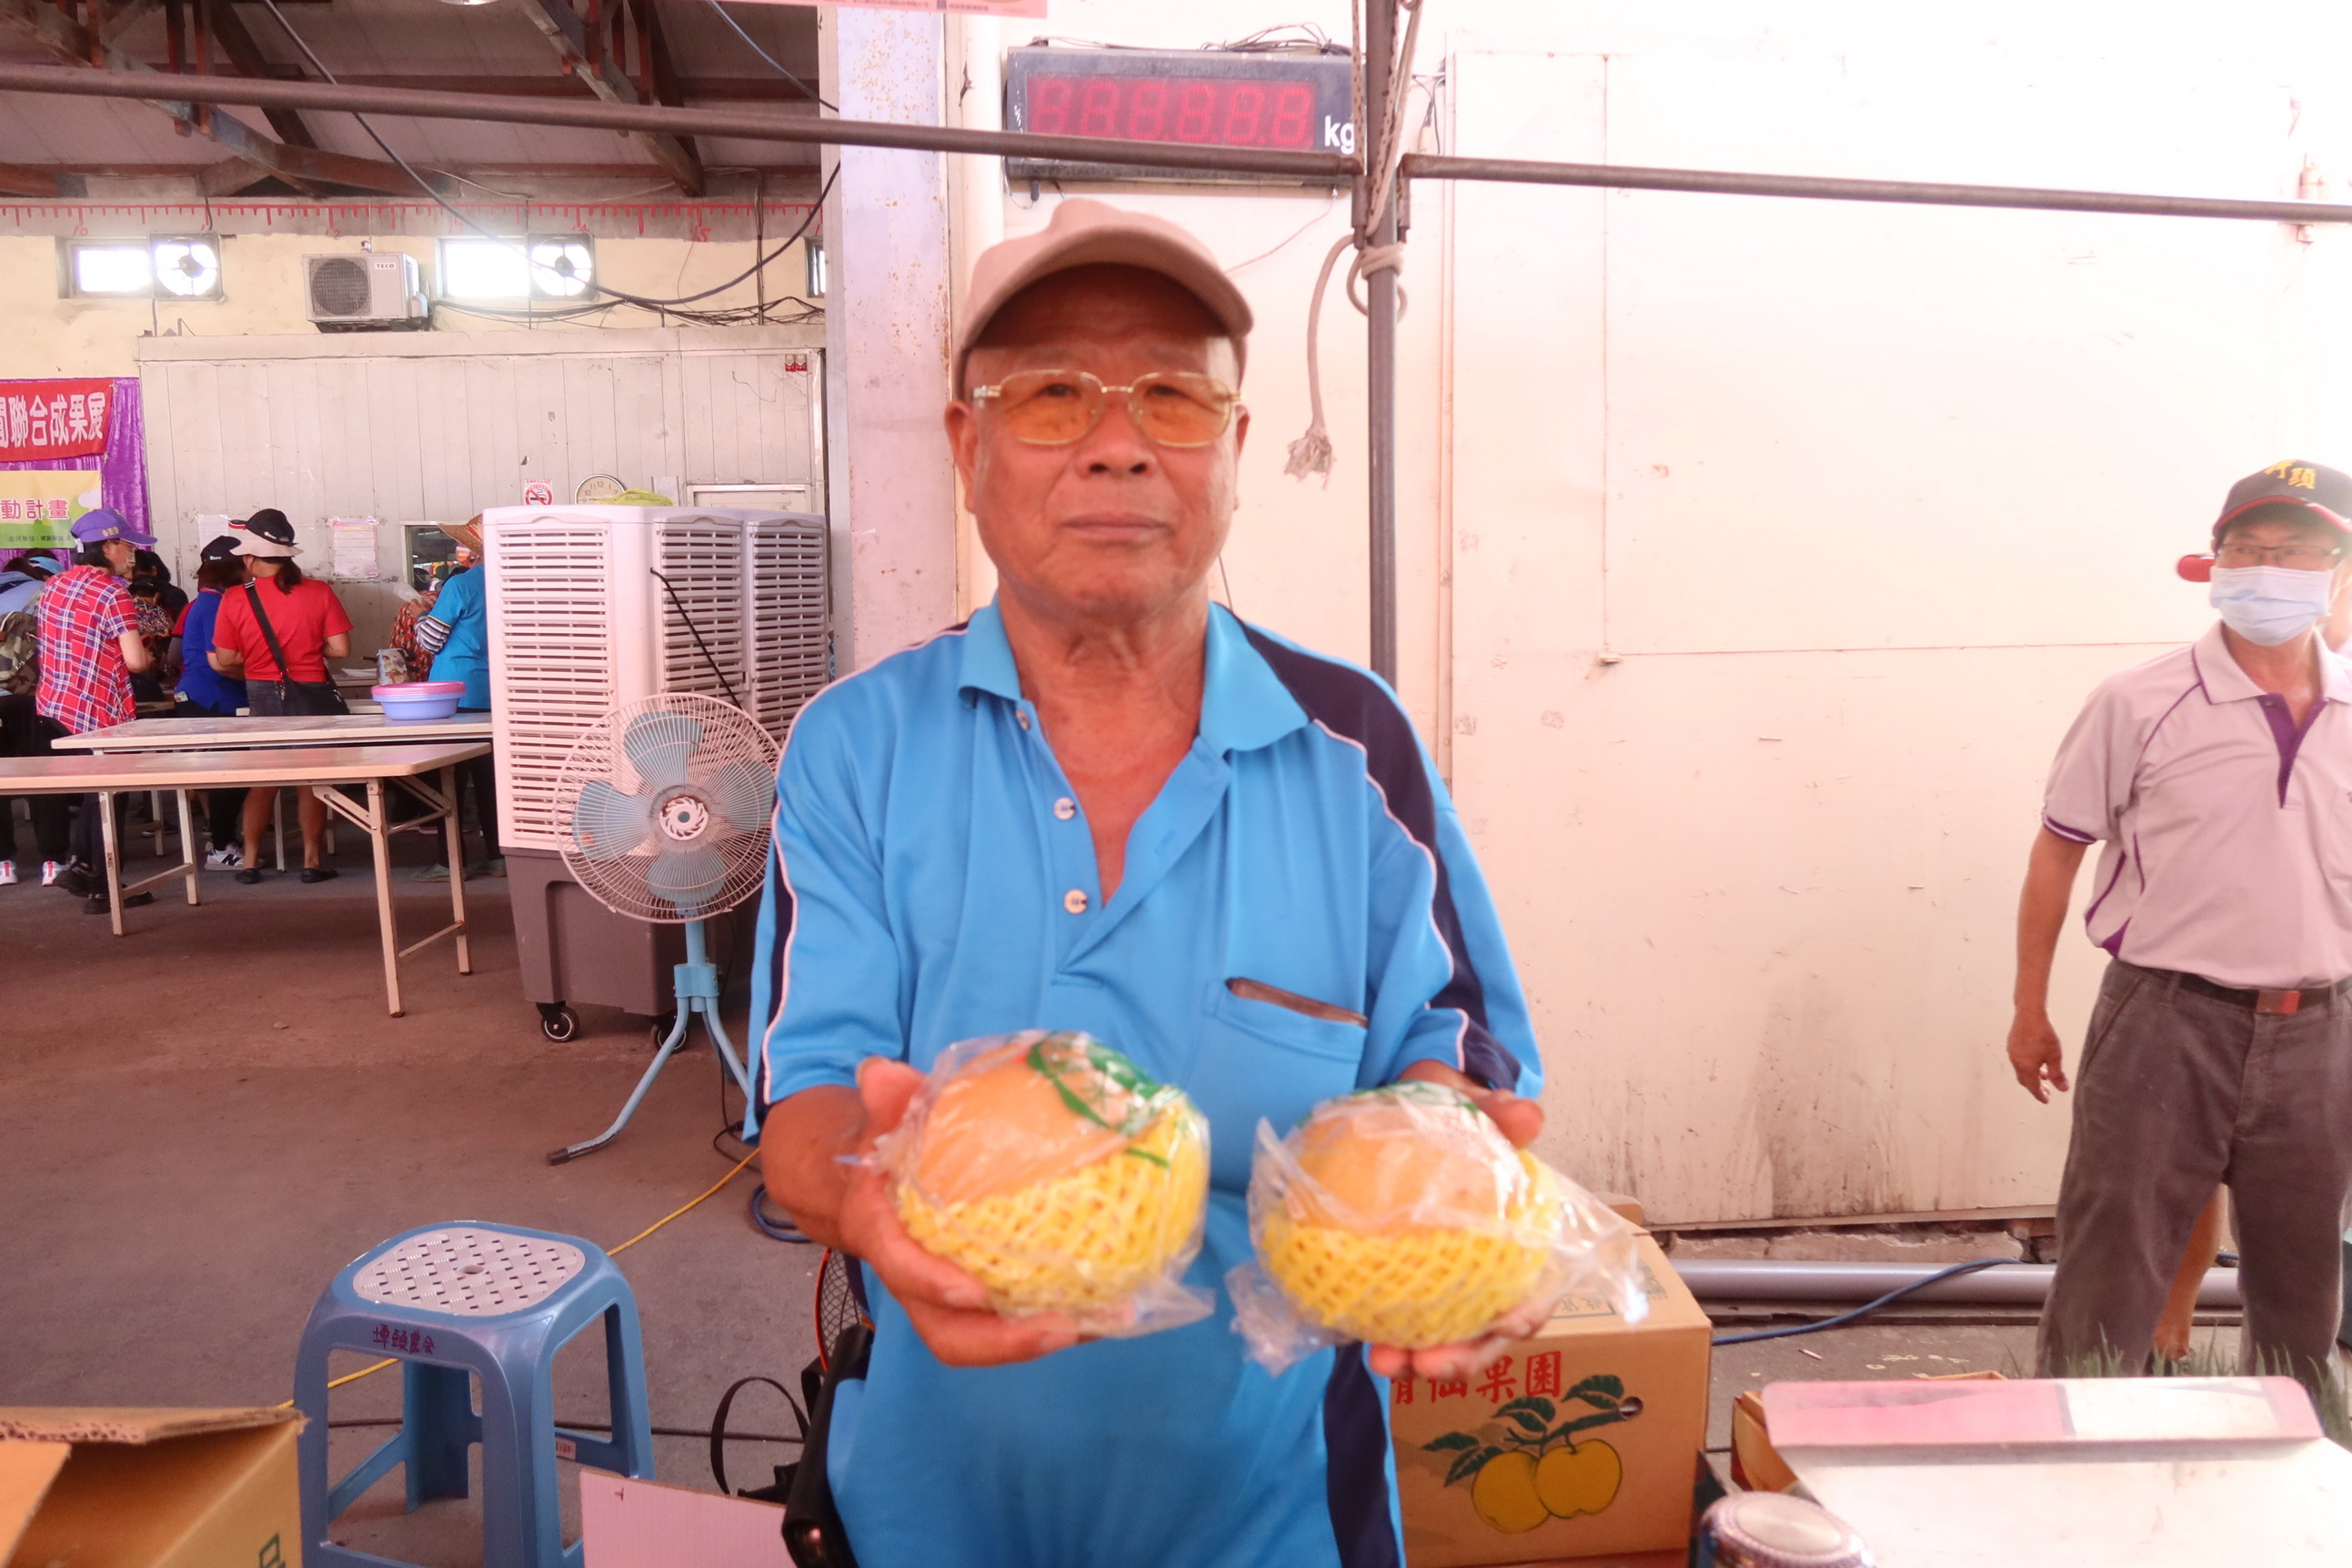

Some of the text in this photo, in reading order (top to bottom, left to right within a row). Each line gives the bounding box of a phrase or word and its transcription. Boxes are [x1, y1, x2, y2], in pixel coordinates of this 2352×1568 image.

[1324, 115, 1355, 155] kg
[597, 480, 605, 488] 12
[1, 498, 69, 520] 動計畫
